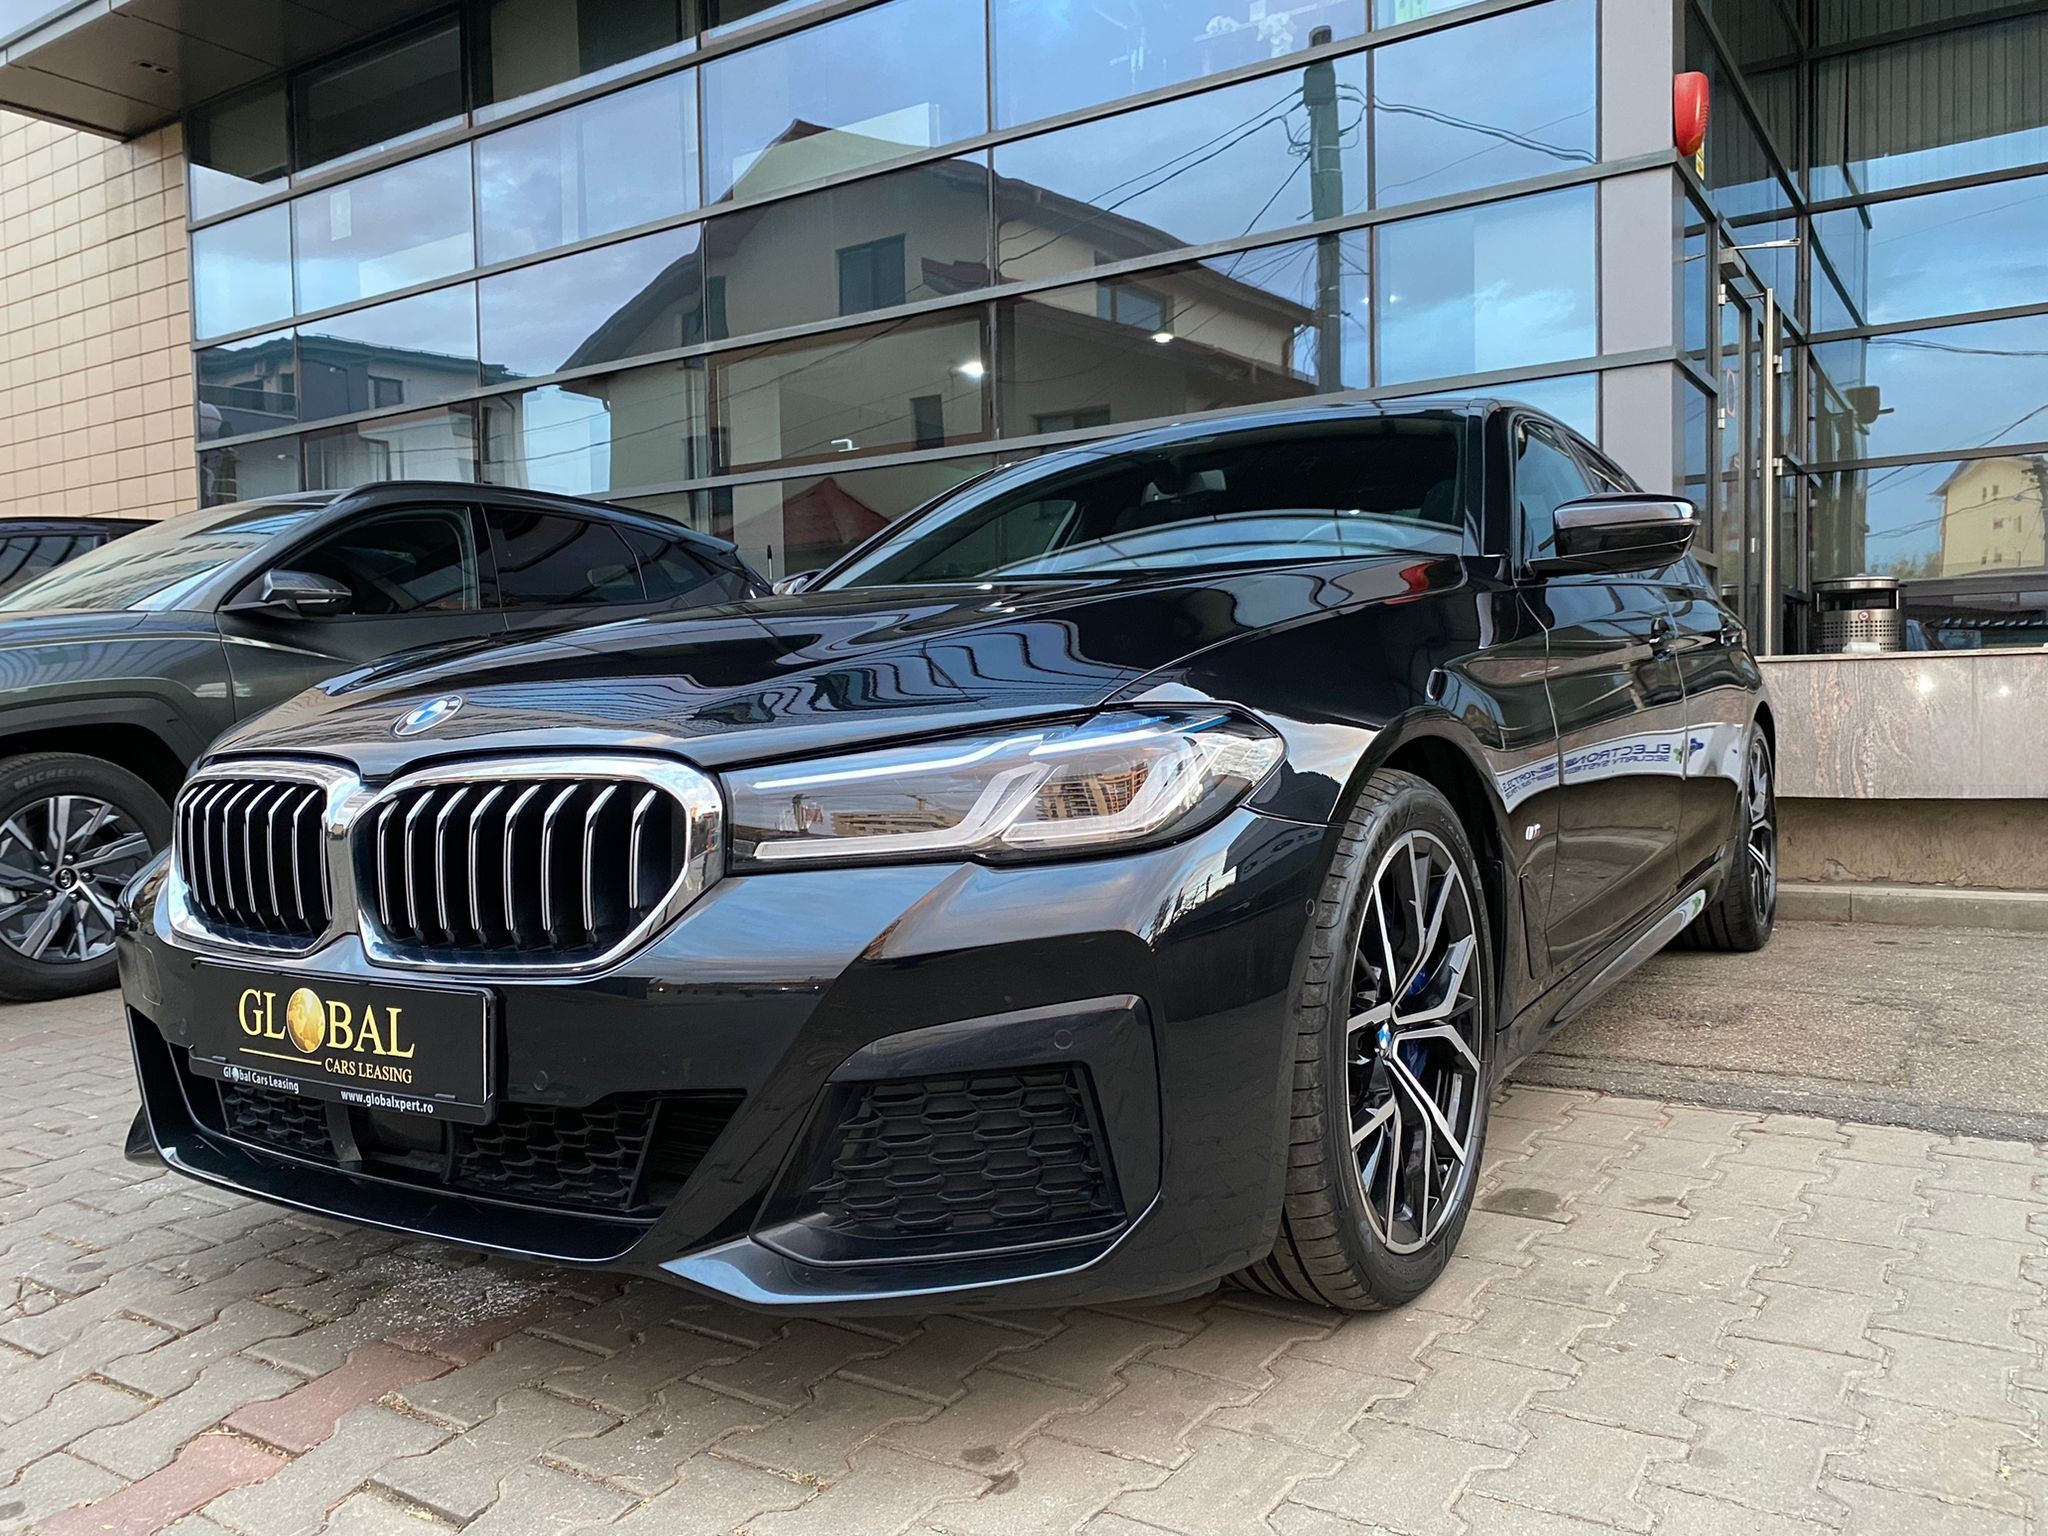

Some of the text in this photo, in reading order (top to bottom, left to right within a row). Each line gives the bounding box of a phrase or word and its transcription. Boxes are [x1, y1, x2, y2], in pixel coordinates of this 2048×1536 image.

[325, 1057, 413, 1085] CARS LEASING
[252, 1072, 268, 1086] Cars
[269, 1075, 299, 1095] Leasing
[340, 1090, 434, 1114] www.globalxpert.ro
